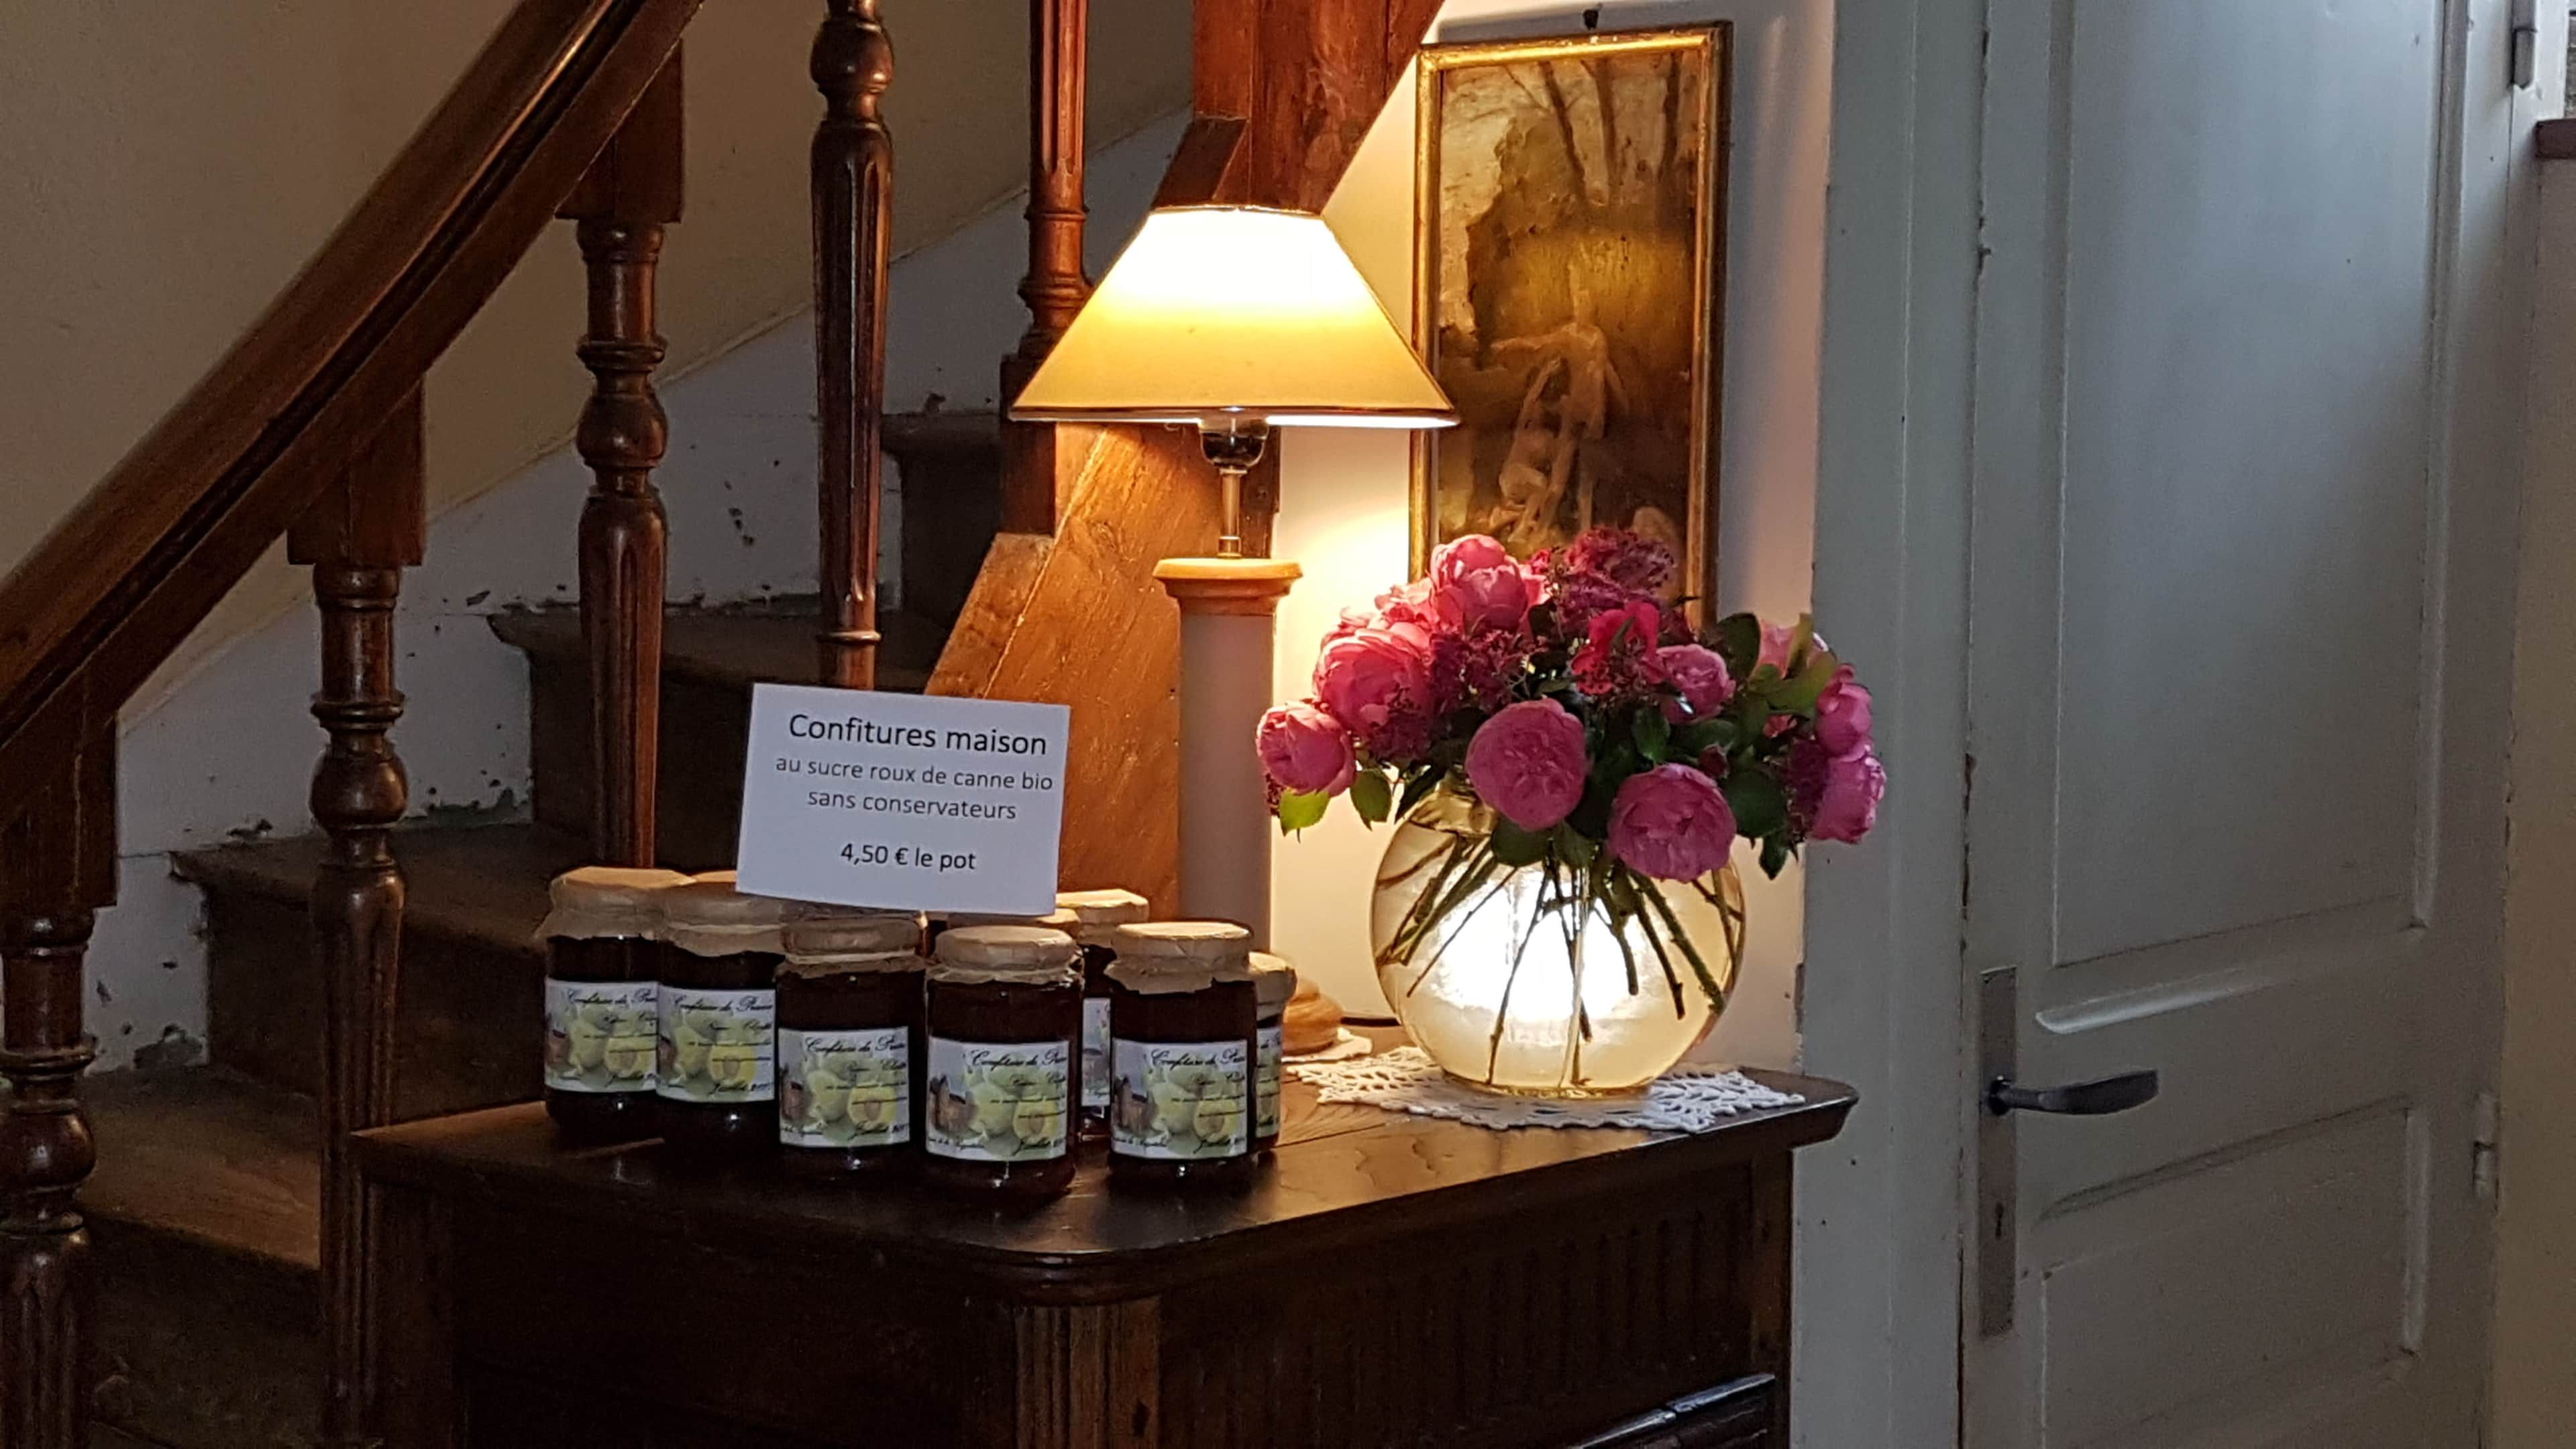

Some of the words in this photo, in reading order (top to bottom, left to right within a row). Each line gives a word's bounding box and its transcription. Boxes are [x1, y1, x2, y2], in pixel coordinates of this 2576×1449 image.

[788, 712, 937, 749] Confitures
[945, 727, 1047, 757] maison
[775, 757, 802, 773] au
[806, 760, 864, 780] sucre
[869, 765, 917, 784] roux
[920, 764, 948, 786] de
[953, 771, 1016, 790] canne
[1021, 770, 1054, 792] bio
[806, 790, 857, 808] sans
[861, 796, 1017, 820] conservateurs
[839, 842, 890, 867] 4,50
[893, 846, 910, 867] €
[914, 846, 934, 869] le
[938, 852, 977, 873] pot
